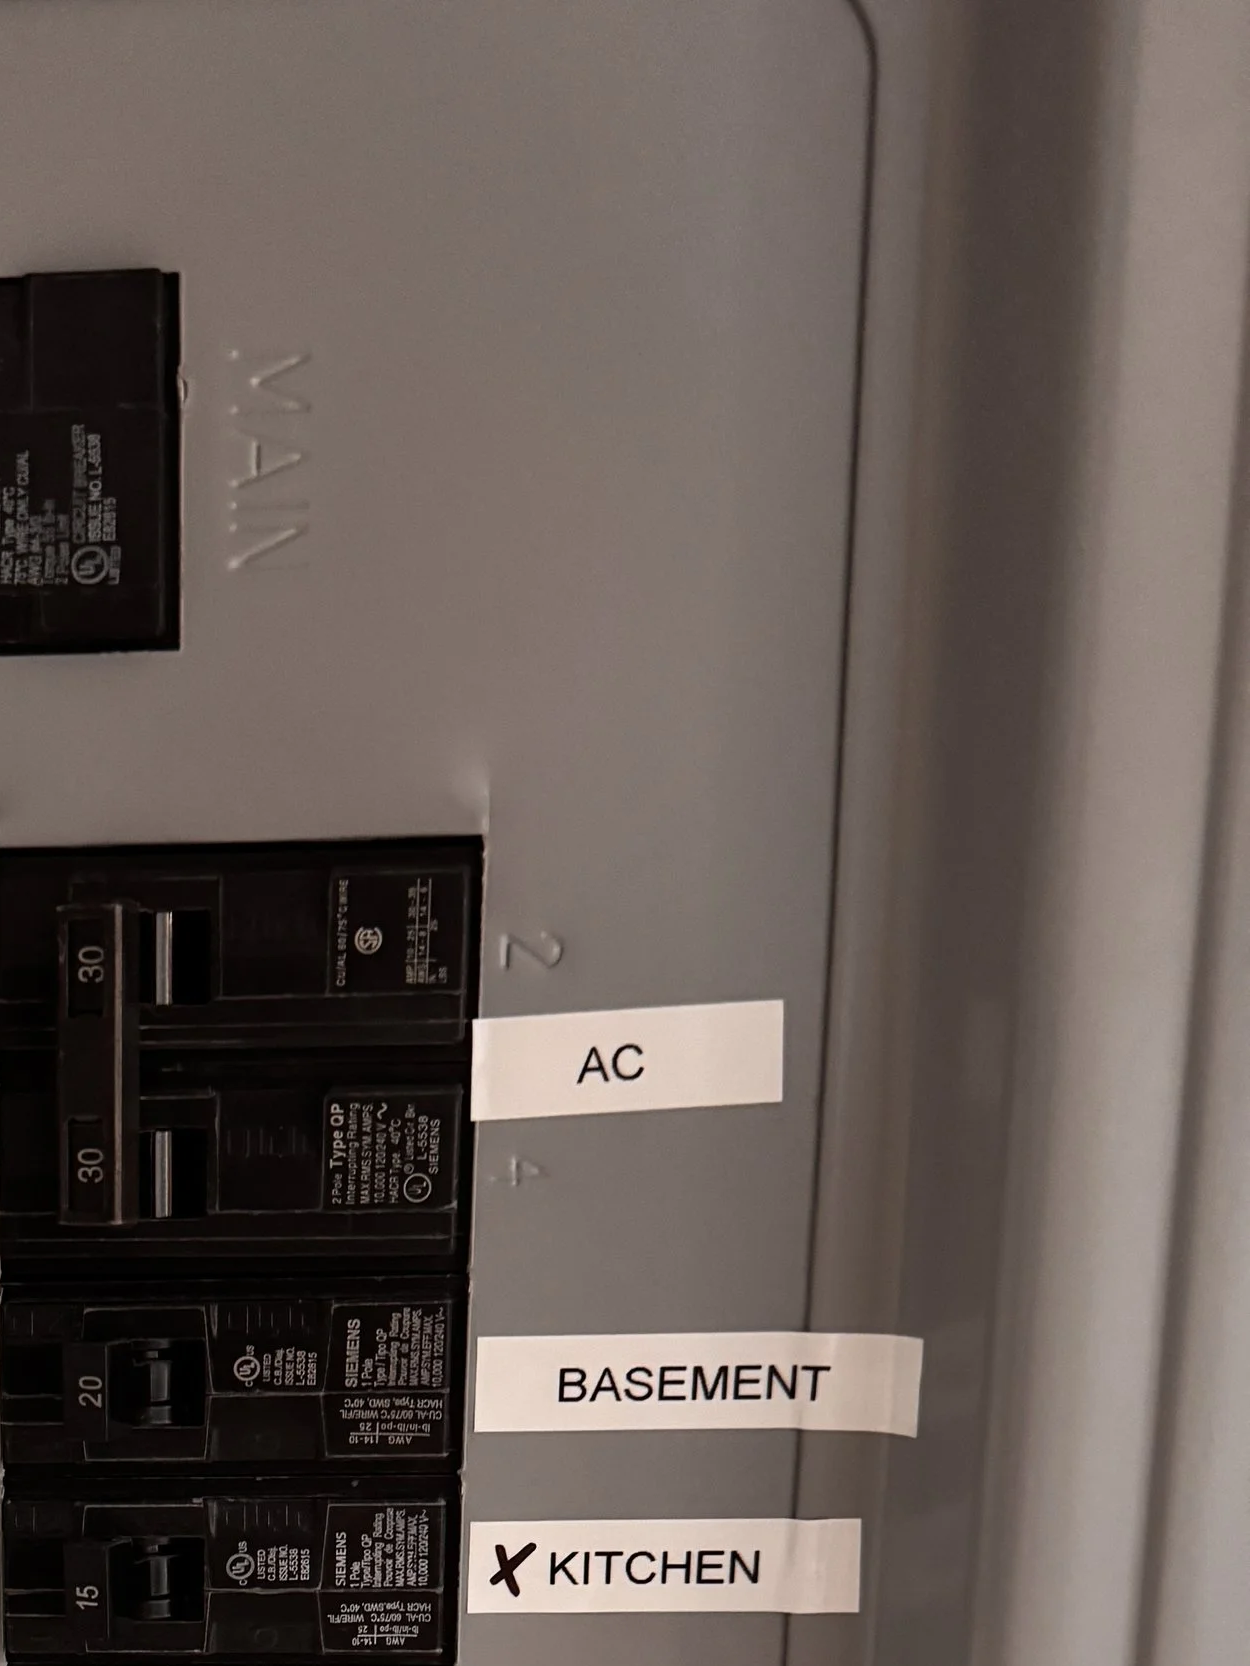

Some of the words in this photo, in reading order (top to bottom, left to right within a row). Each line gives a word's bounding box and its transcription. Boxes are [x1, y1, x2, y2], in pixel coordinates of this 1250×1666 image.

[77, 945, 104, 983] 30
[577, 1043, 645, 1084] AC
[330, 1103, 344, 1127] QP
[346, 1102, 361, 1140] Rating
[329, 1130, 346, 1169] Type
[428, 1118, 441, 1175] SIEMENS
[76, 1147, 104, 1183] 30
[263, 1353, 271, 1382] LISTED
[296, 1350, 306, 1386] L-5538
[345, 1318, 361, 1388] SIEMENS
[361, 1358, 373, 1380] Pole
[77, 1376, 102, 1408] 20
[557, 1365, 831, 1402] BASEMENT
[257, 1549, 266, 1580] LISTED
[289, 1548, 299, 1581] L-5538
[301, 1548, 311, 1581] E82615
[335, 1531, 347, 1587] SIEMENS
[350, 1561, 361, 1581] Pole
[549, 1550, 760, 1585] KITCHEN
[75, 1585, 98, 1610] 15
